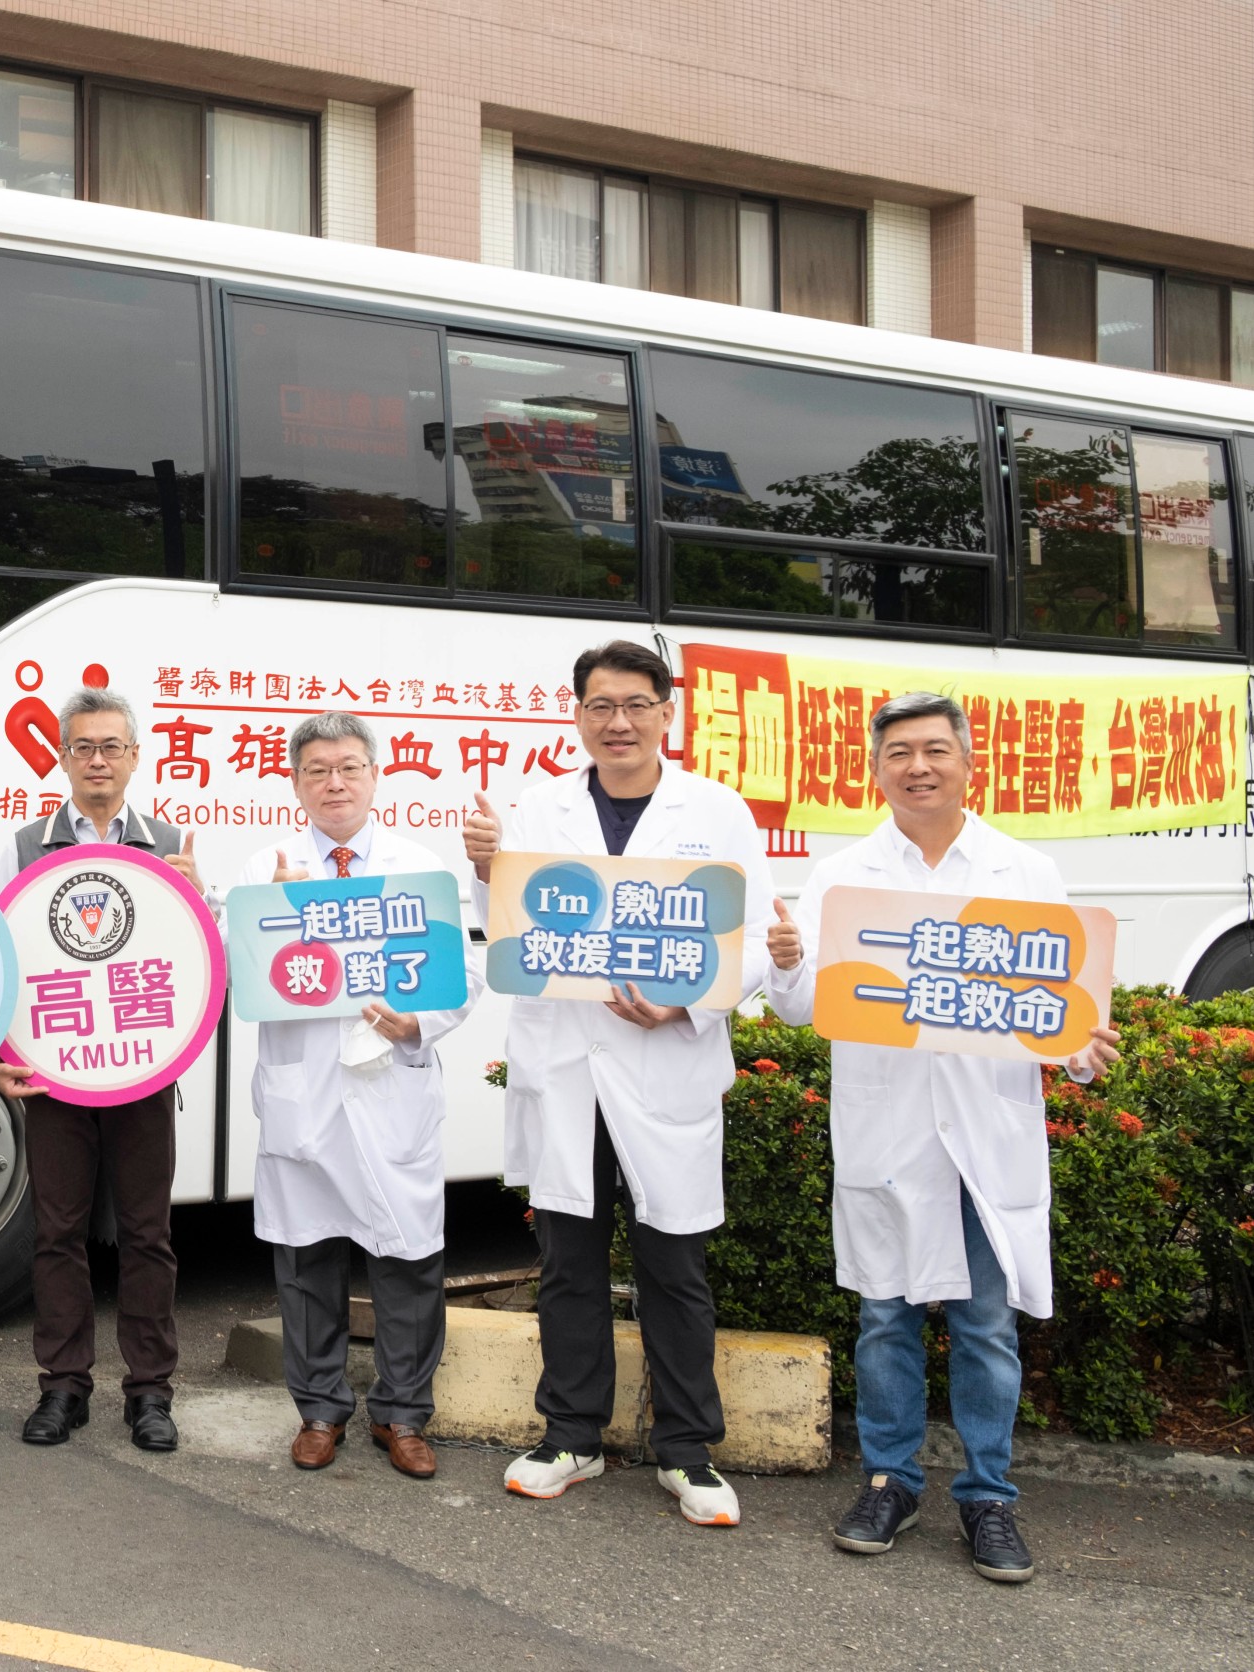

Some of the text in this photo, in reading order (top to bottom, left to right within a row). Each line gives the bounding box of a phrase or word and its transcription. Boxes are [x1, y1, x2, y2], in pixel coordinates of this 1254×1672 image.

[153, 665, 575, 714] 醫療財團法人台灣血液基金會
[151, 714, 580, 791] 高雄血中心
[153, 797, 309, 832] Kaohsiung
[260, 894, 427, 943] 一起捐血
[537, 887, 590, 915] I'm
[613, 882, 707, 930] 熱血
[522, 929, 704, 982] 救援王牌
[860, 919, 1070, 980] 一起熱血
[26, 958, 176, 1040] 高醫
[856, 975, 1065, 1035] 一起救命
[59, 1039, 154, 1072] KMUH
